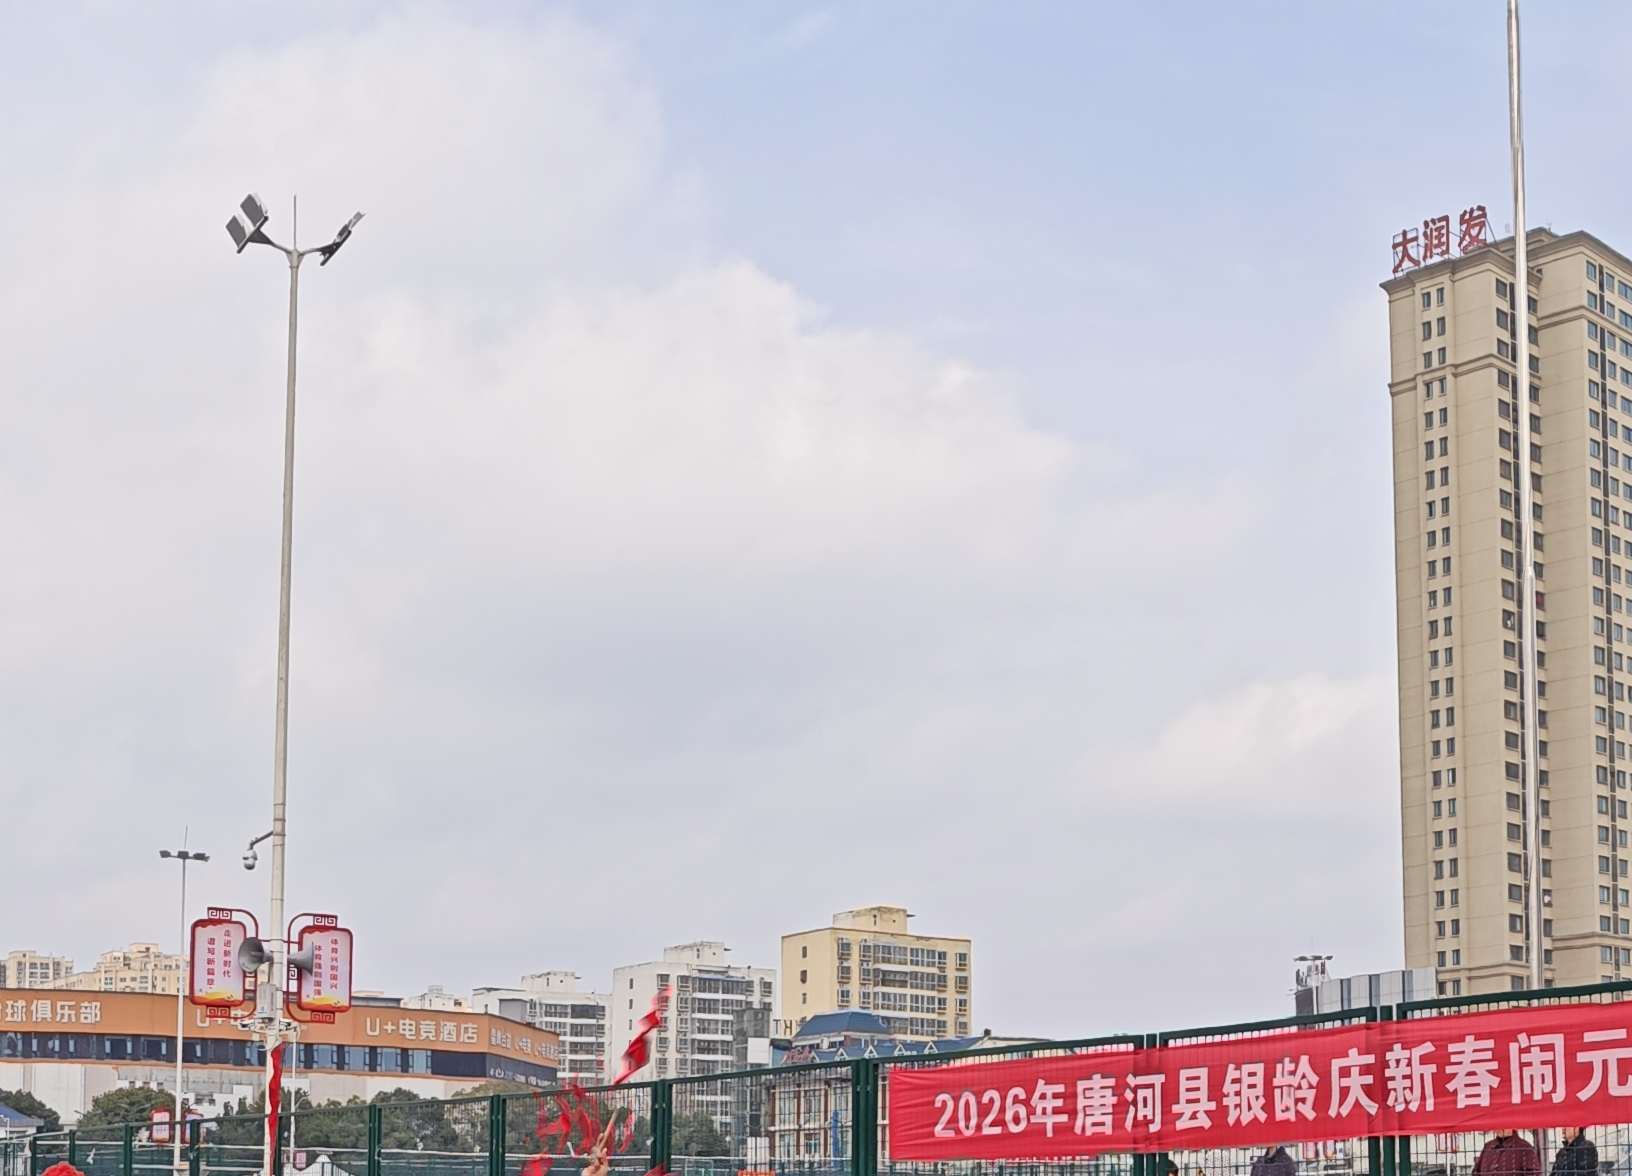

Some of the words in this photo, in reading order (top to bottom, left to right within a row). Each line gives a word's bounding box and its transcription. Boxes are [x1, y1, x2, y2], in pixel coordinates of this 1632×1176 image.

[1392, 205, 1487, 274] 大润发
[314, 945, 322, 996] 体育强则国强
[330, 938, 338, 989] 体育兴则国兴
[366, 1016, 478, 1044] U+电竞酒店
